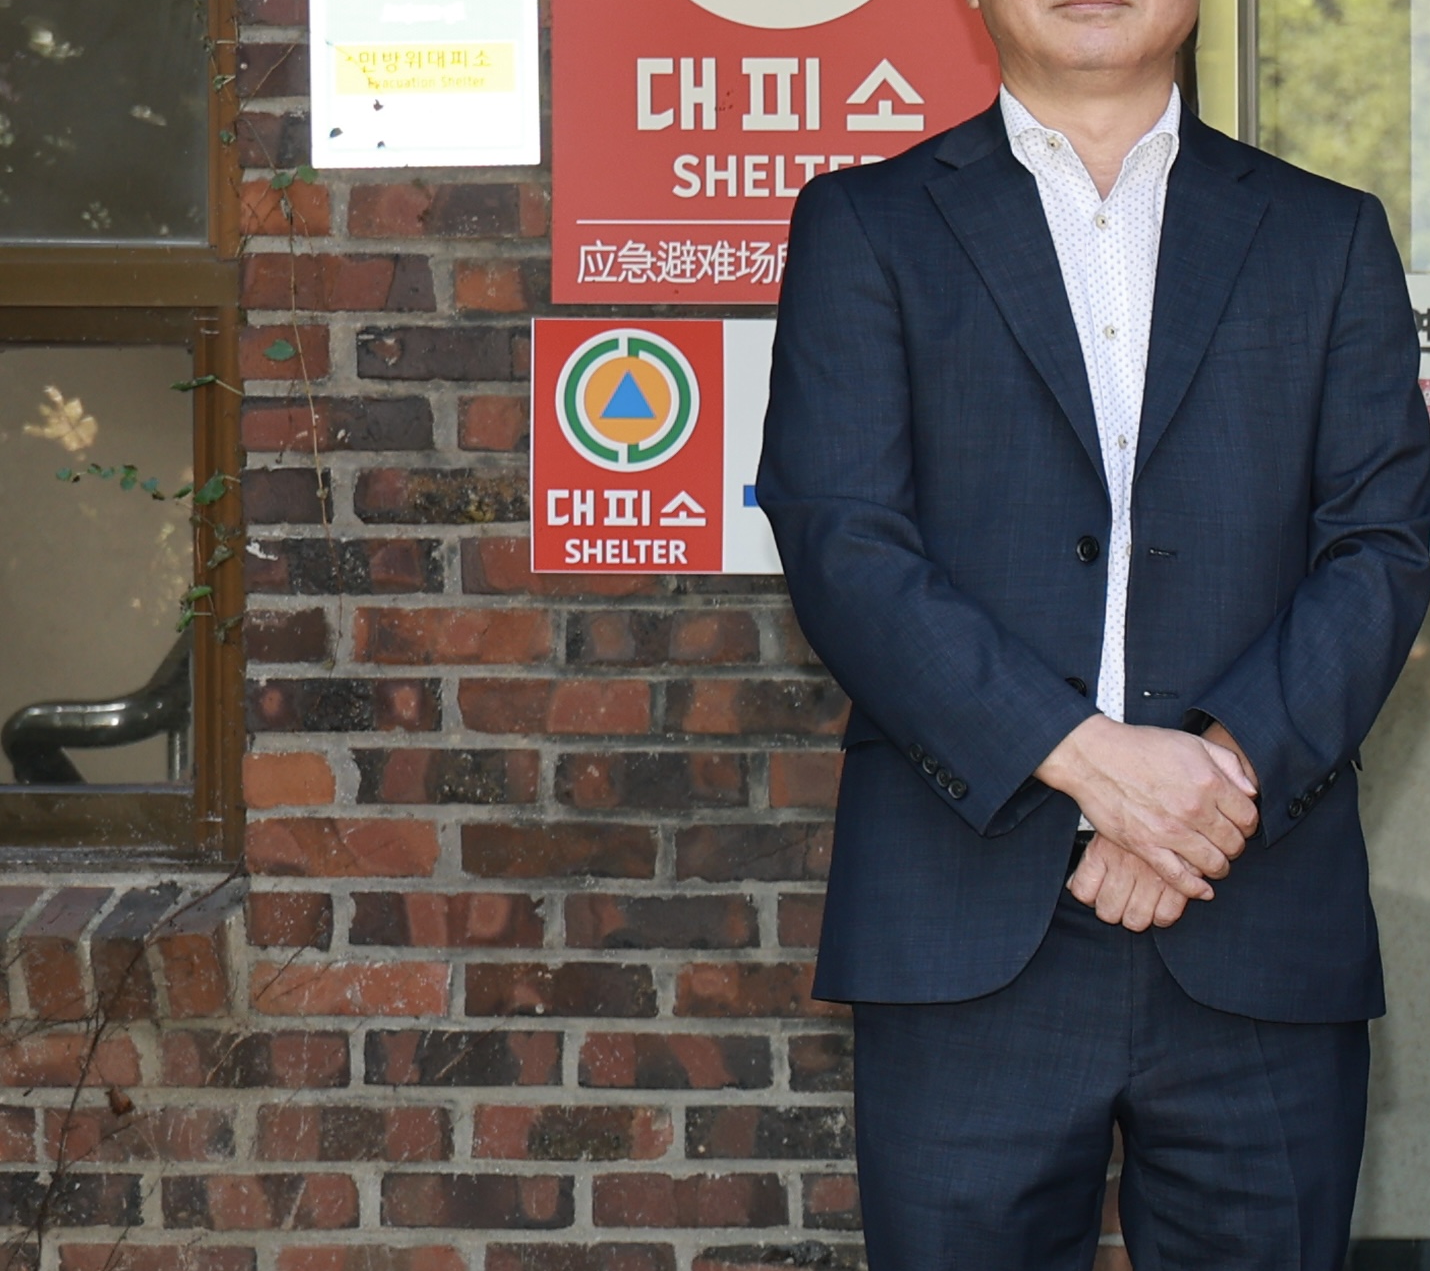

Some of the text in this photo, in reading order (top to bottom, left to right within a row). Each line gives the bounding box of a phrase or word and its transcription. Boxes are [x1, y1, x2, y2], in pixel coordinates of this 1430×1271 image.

[359, 49, 492, 74] 민방위대피소
[441, 75, 485, 88] Shelter
[636, 56, 926, 132] 대피소
[673, 154, 888, 198] SHELT
[547, 489, 707, 527] 대피소
[564, 539, 688, 564] SHELTER
